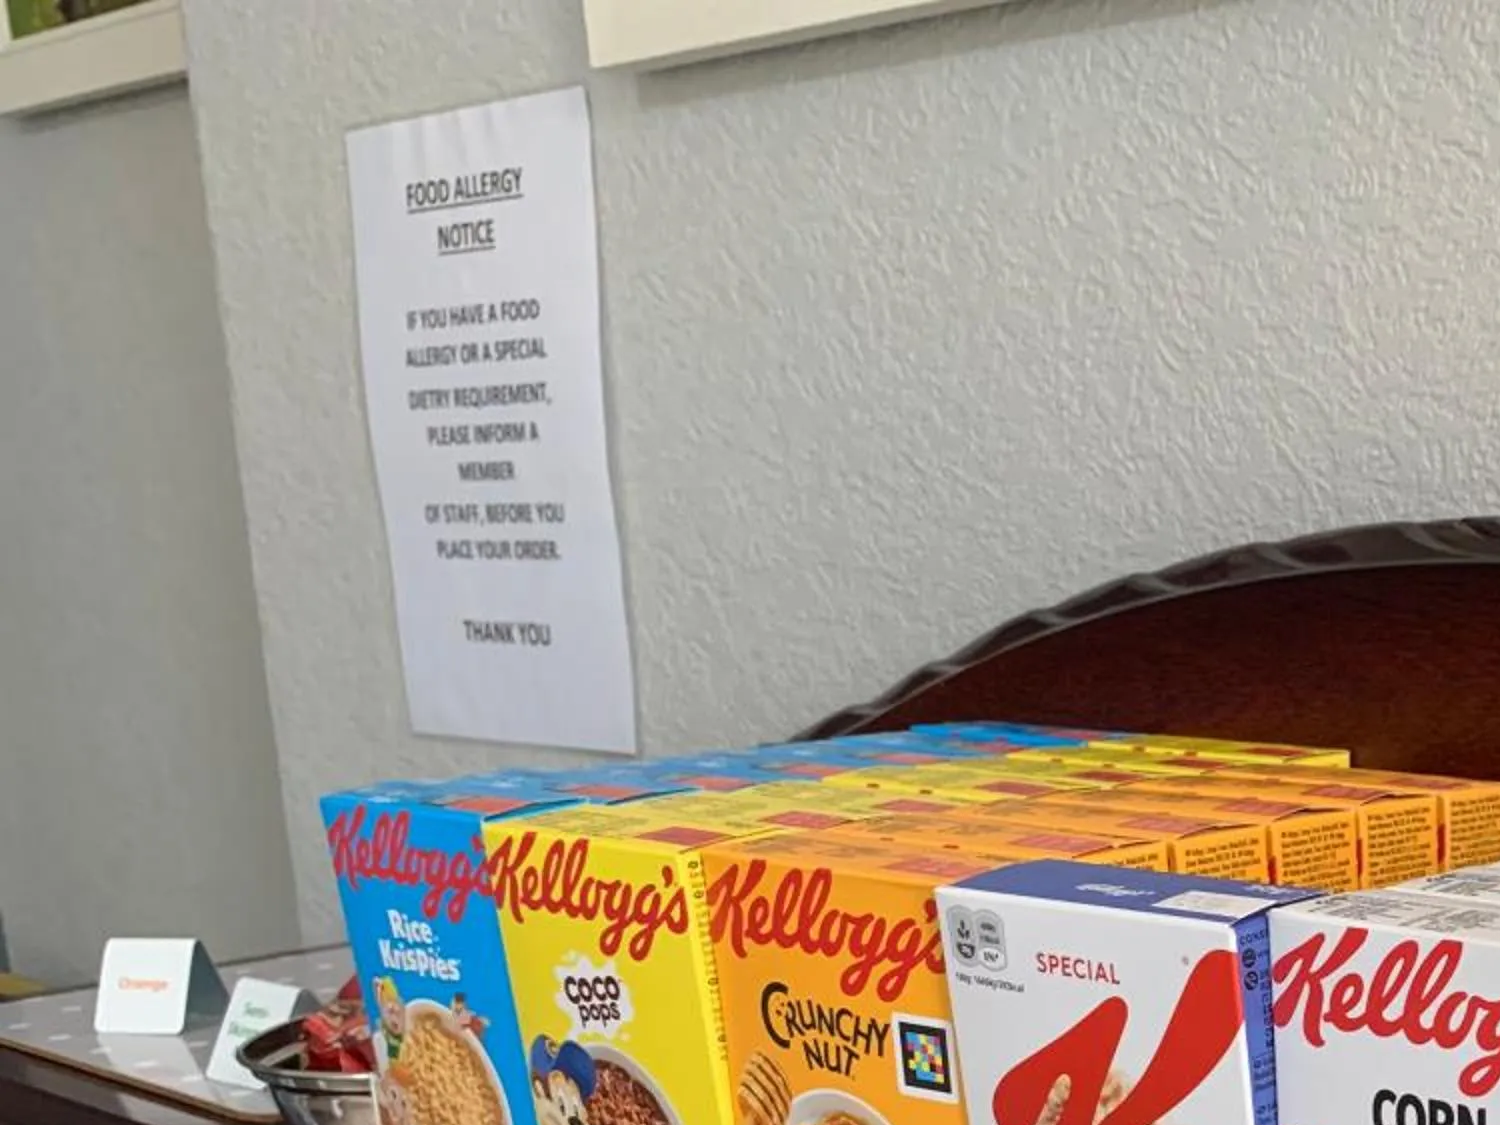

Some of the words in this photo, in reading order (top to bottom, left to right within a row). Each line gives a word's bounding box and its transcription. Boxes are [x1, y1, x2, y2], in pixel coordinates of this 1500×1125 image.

[405, 179, 450, 207] FOOD
[454, 167, 523, 199] ALLERGY
[437, 218, 495, 249] NOTICE
[406, 310, 417, 331] IF
[421, 308, 447, 329] YOU
[450, 304, 486, 326] HAVE
[487, 303, 499, 322] A
[501, 299, 541, 320] FOOD
[406, 345, 457, 368] ALLERGY
[461, 343, 480, 364] OR
[482, 343, 492, 361] A
[494, 337, 547, 361] SPECIAL
[427, 425, 471, 447] PLEASE
[473, 423, 527, 444] INFORM
[529, 421, 540, 441] A
[458, 461, 516, 482] MEMBER
[424, 503, 441, 525] OF
[486, 503, 533, 524] BEFORE
[536, 503, 566, 524] YOU
[435, 540, 474, 561] PLACE
[475, 540, 512, 560] YOUR
[463, 620, 516, 644] THANK
[518, 623, 552, 646] YOU
[488, 831, 690, 962] Kellogg's
[386, 908, 438, 944] Rice
[378, 937, 461, 982] Krispies
[1035, 951, 1121, 986] SPECIAL
[761, 981, 890, 1057] CRUNCHY
[802, 1039, 860, 1079] NUT
